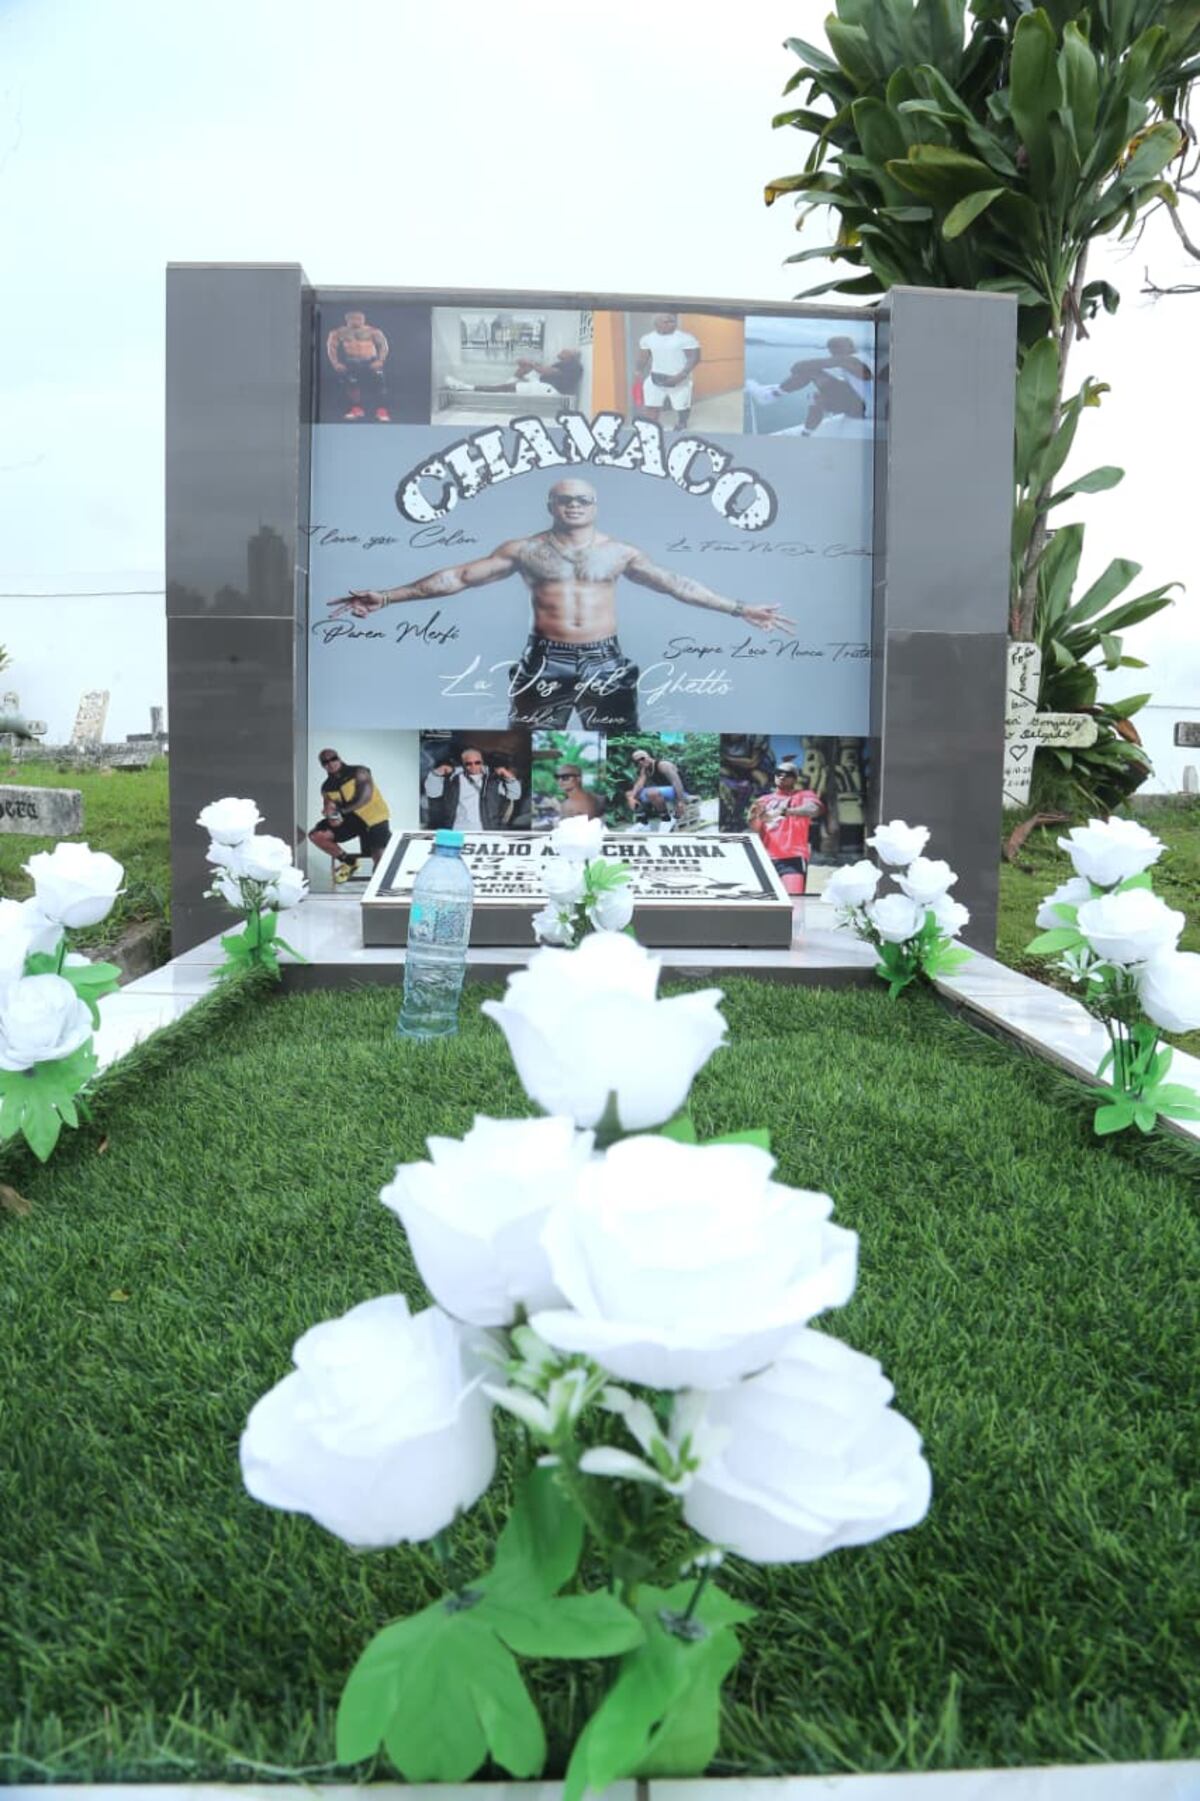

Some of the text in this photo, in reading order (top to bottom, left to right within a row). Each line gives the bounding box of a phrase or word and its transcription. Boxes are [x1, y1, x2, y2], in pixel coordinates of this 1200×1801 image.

[396, 411, 778, 532] CHAMACO
[320, 529, 360, 546] love
[730, 636, 767, 658] Loco
[439, 655, 732, 706] La Voz del Ghetto
[428, 843, 727, 858] SALIO ACHA MINA
